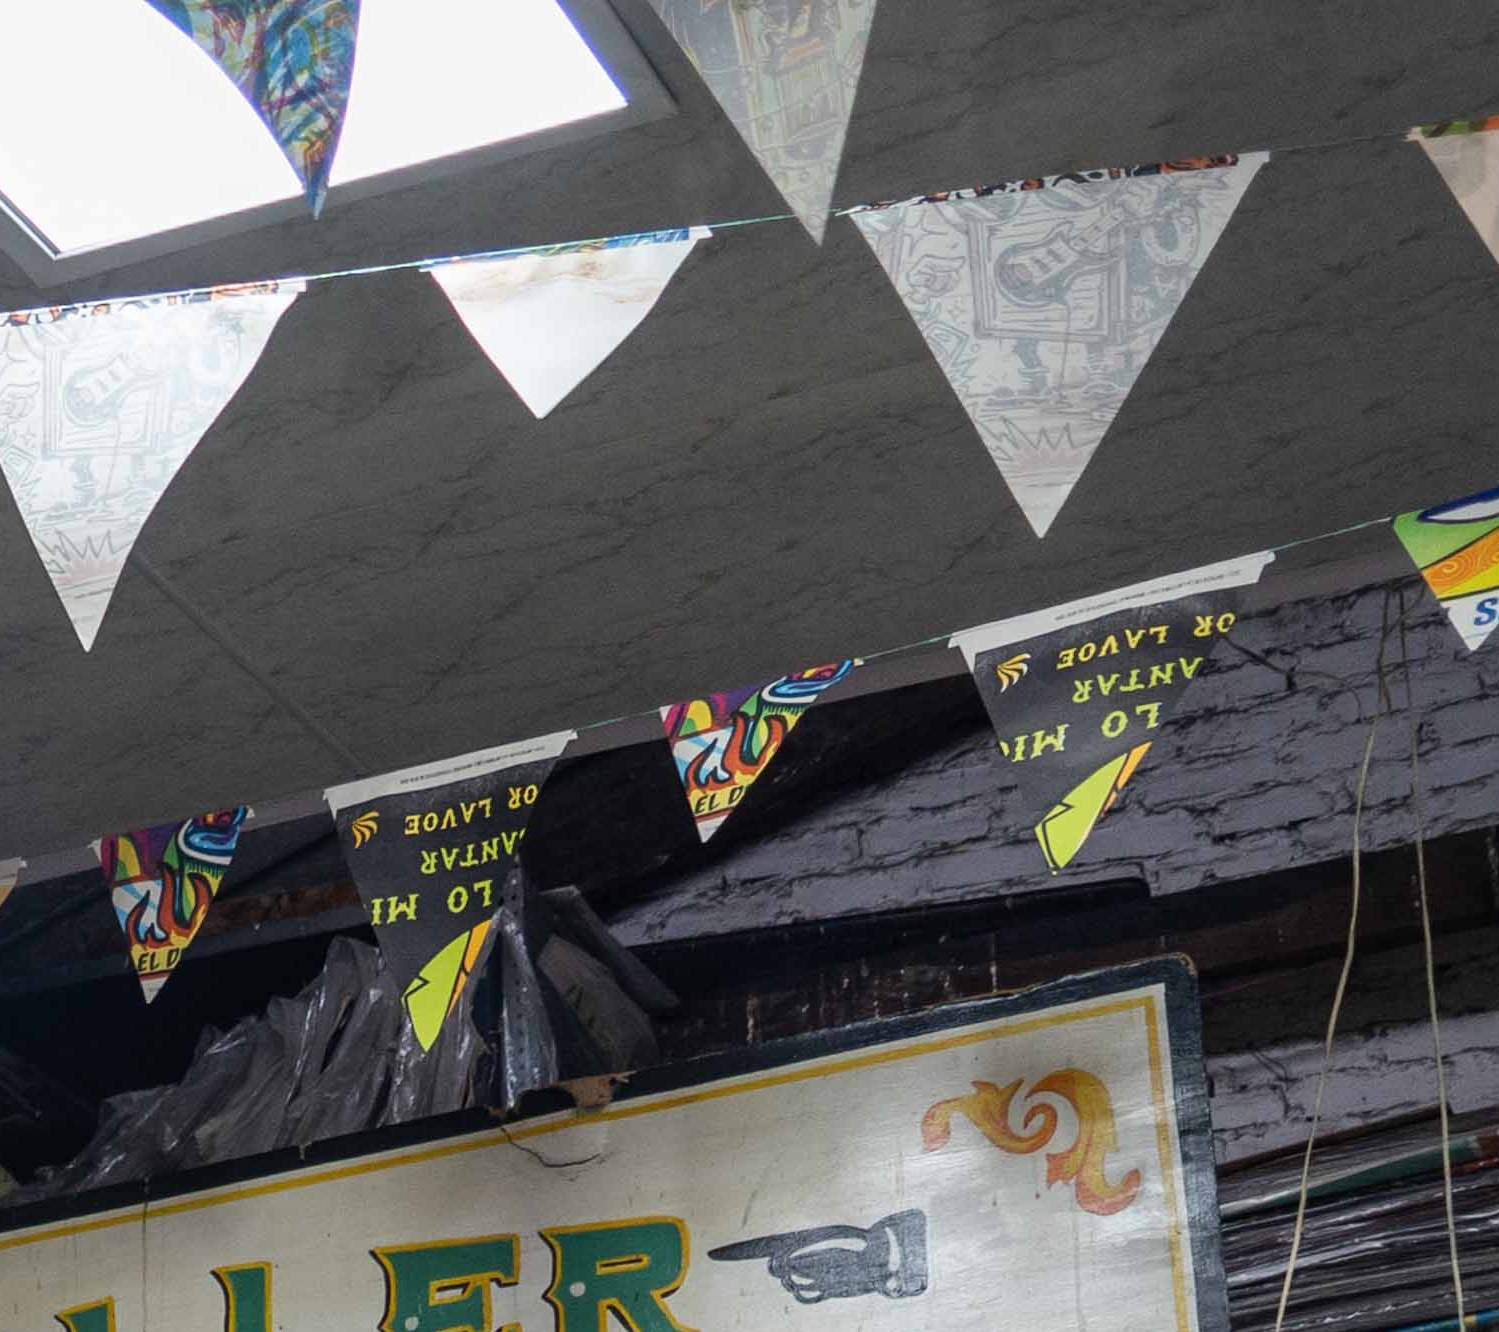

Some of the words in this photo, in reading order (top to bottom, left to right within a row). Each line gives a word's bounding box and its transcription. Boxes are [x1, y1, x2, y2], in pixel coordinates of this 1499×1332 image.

[1057, 623, 1170, 671] LAVOE
[1102, 701, 1162, 740] LO
[403, 797, 493, 838] LAVOE
[418, 826, 528, 876] ANTAR
[447, 879, 494, 915] LO
